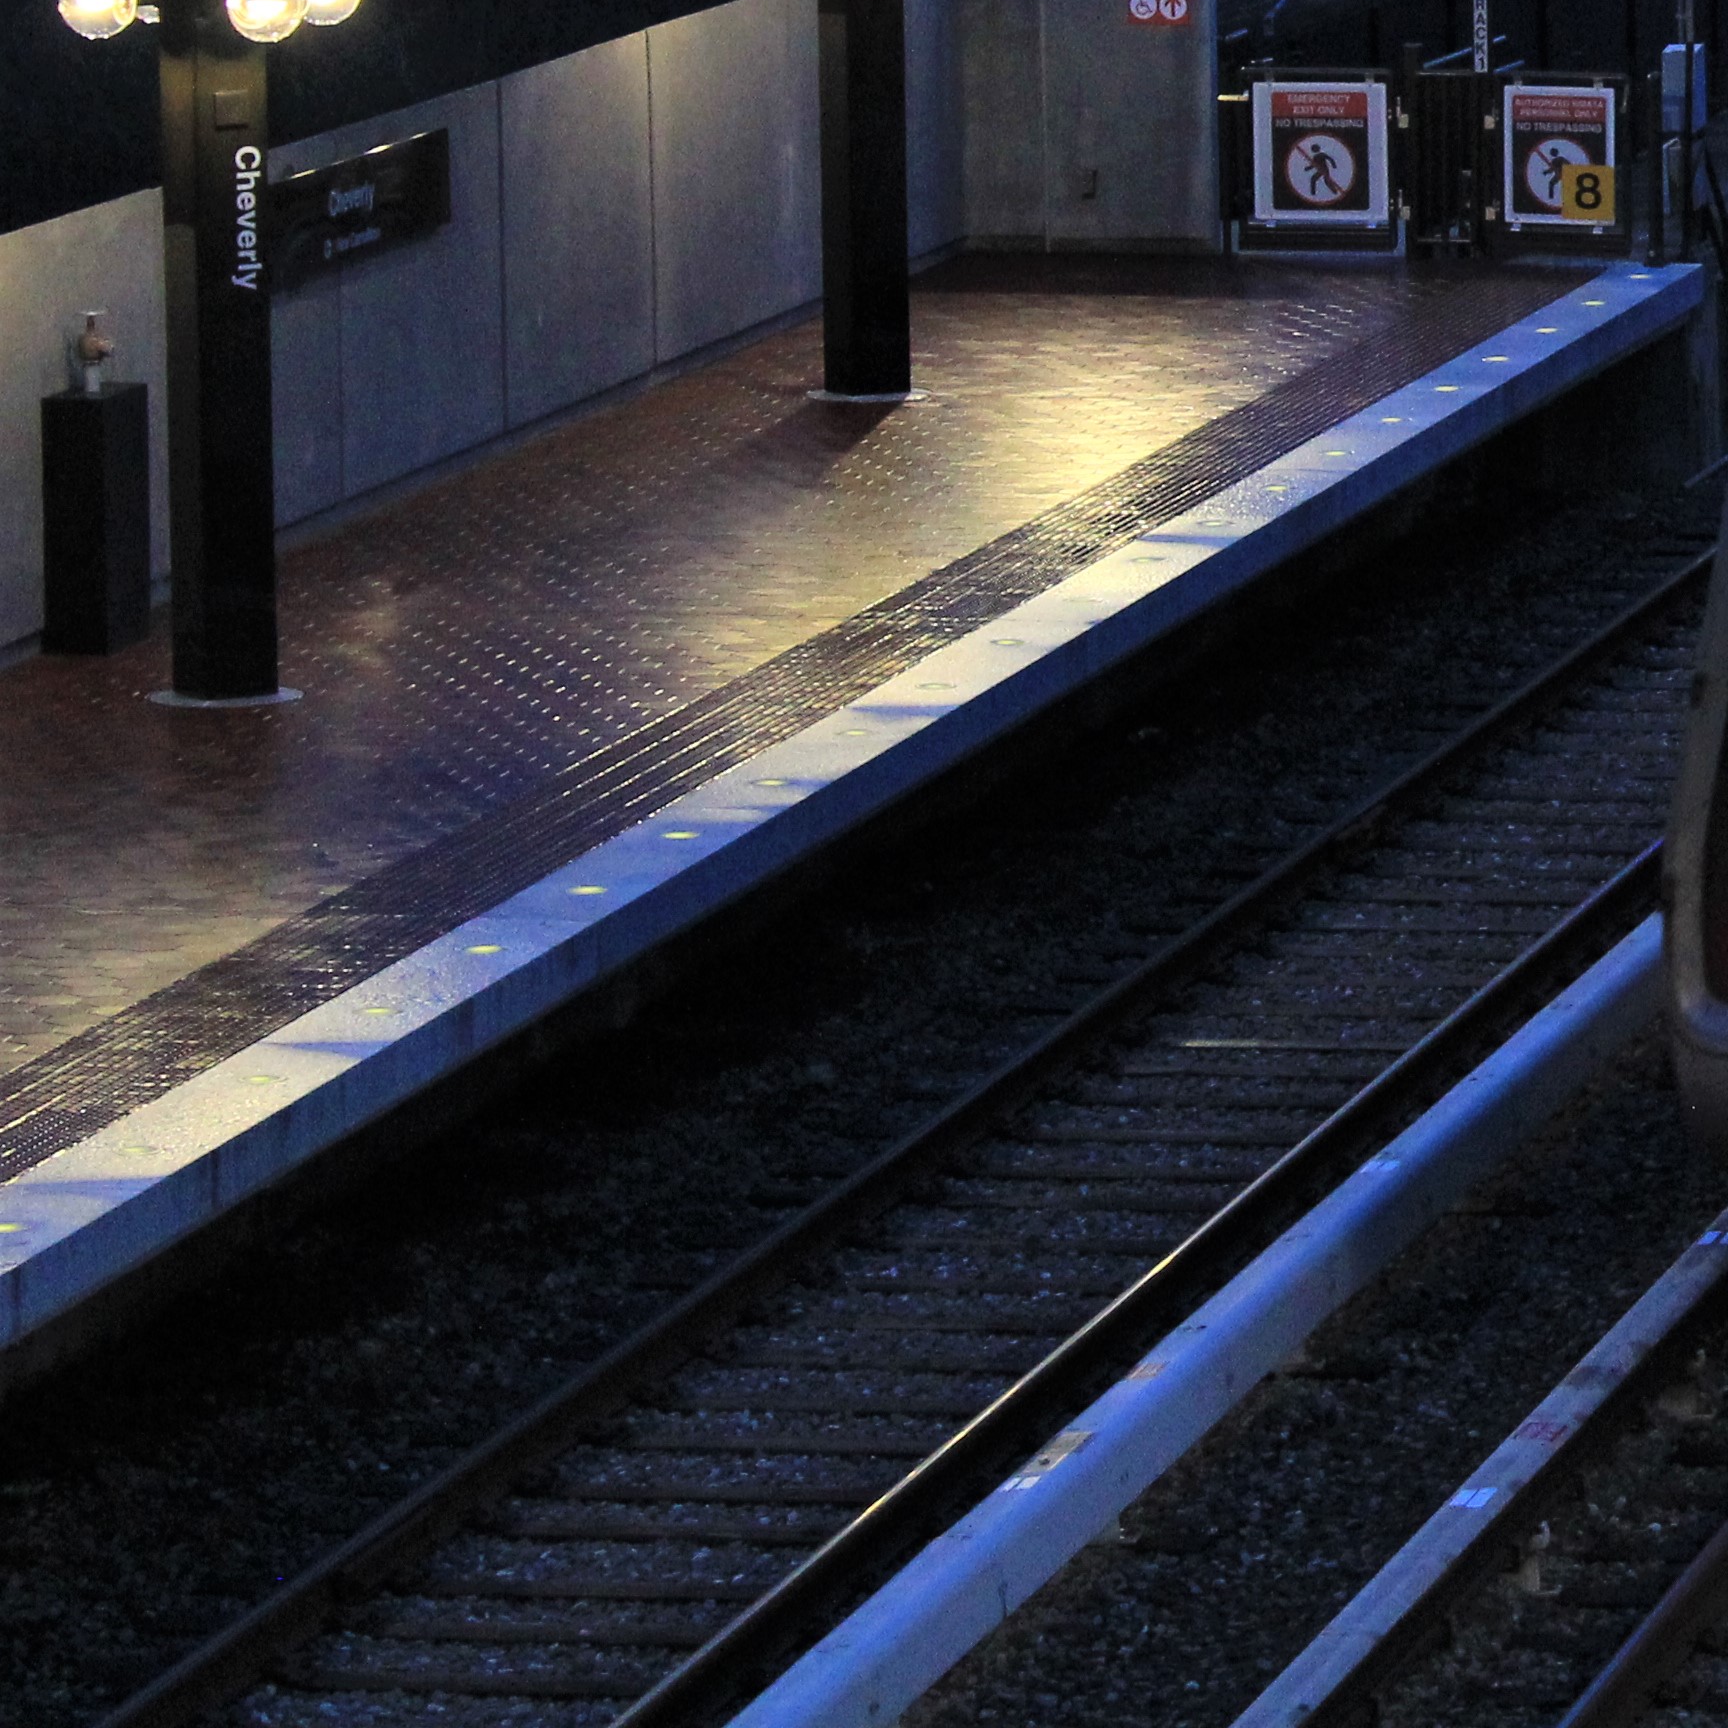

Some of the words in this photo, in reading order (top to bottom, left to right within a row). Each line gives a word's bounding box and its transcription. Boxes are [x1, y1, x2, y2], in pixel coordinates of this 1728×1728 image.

[1287, 94, 1350, 103] EMERGENCY
[1293, 105, 1314, 114] EXIT
[1317, 105, 1345, 114] ONLY
[1275, 118, 1291, 128] NO
[1294, 118, 1364, 128] TRESPASSING
[1516, 121, 1532, 131] NO
[1534, 121, 1602, 133] TRESPASSING
[1575, 172, 1602, 210] 8
[231, 145, 263, 290] Cheverly
